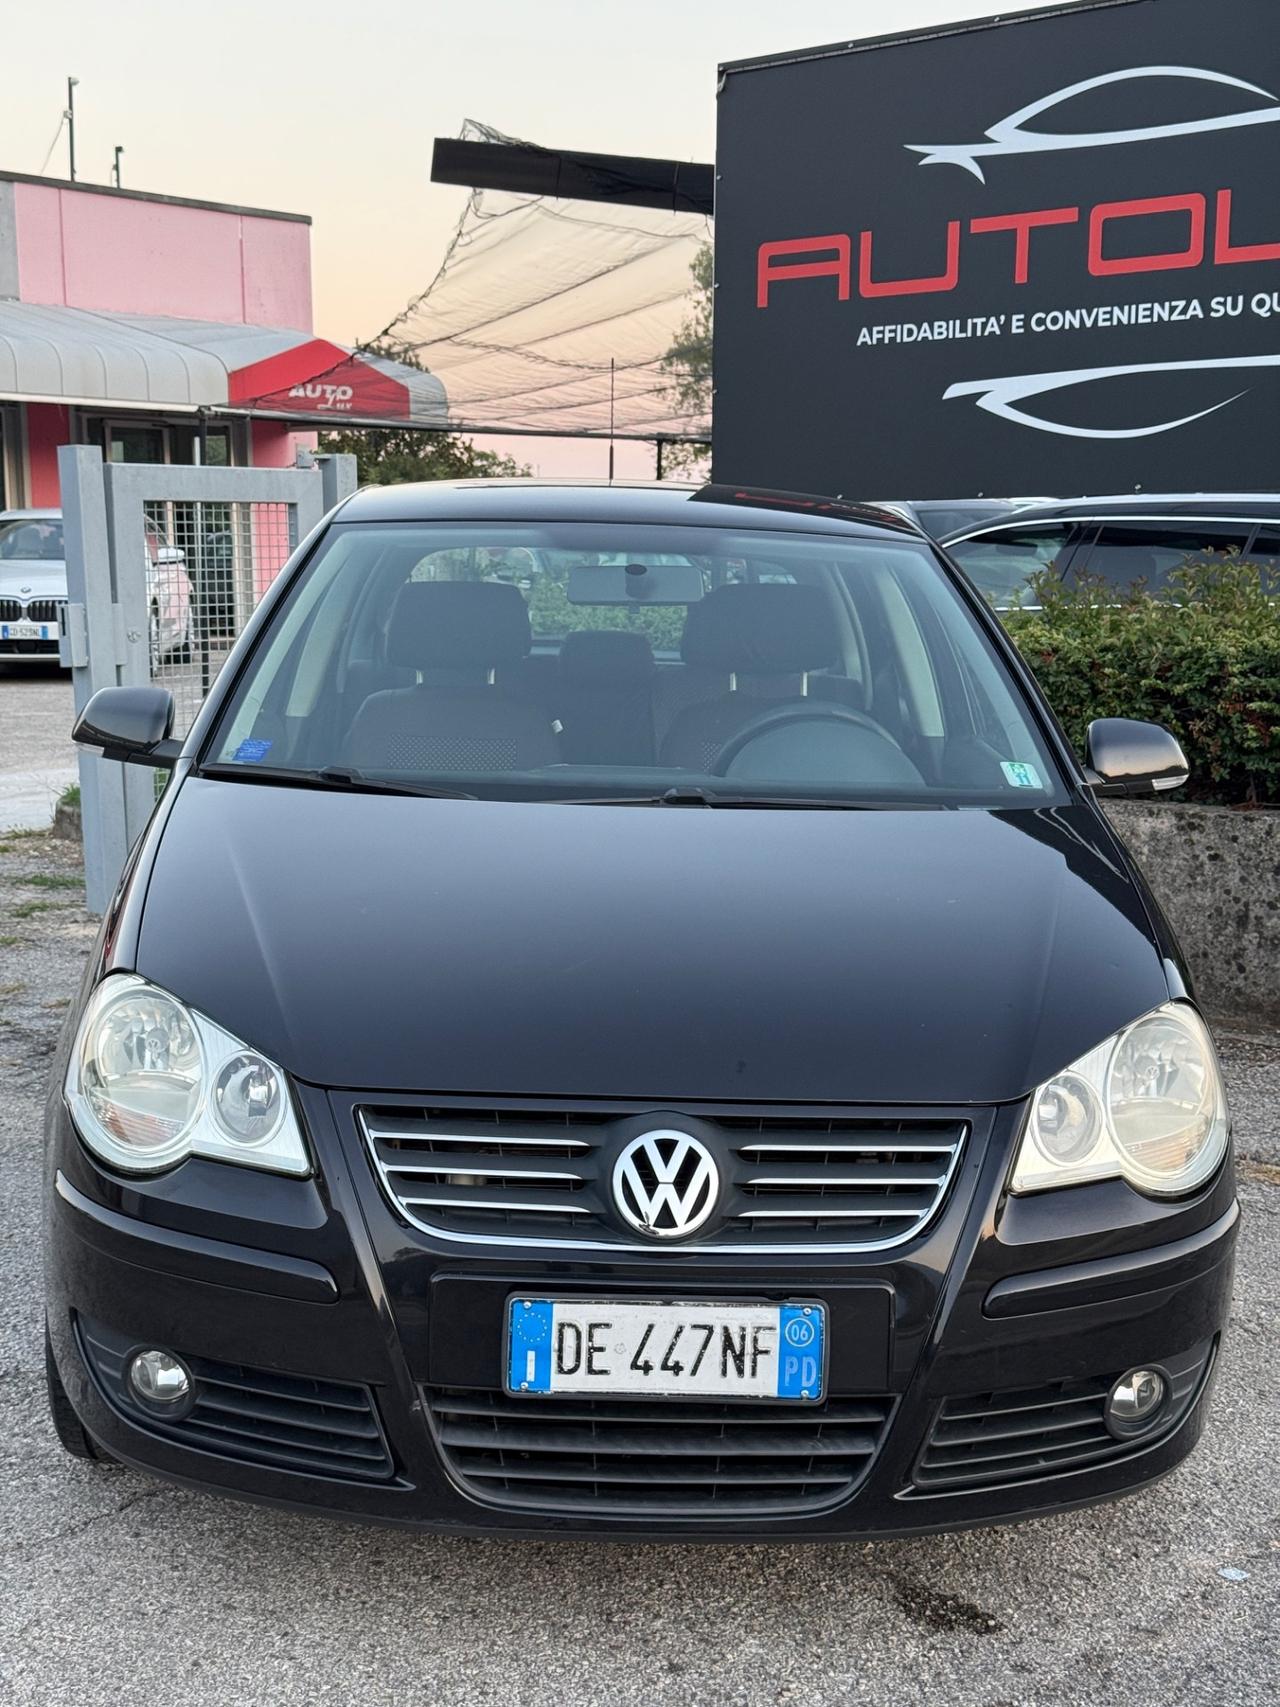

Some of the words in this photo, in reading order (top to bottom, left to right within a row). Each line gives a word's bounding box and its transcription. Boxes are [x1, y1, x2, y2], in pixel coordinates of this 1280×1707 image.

[757, 189, 1280, 308] AUTOL
[1011, 314, 1025, 334] E
[1031, 298, 1204, 332] CONVENIENZA
[1210, 295, 1244, 318] SU
[288, 384, 353, 400] AUTO
[555, 1322, 613, 1376] DE
[629, 1323, 777, 1378] 447NF
[790, 1324, 809, 1342] 06
[784, 1355, 817, 1388] PD
